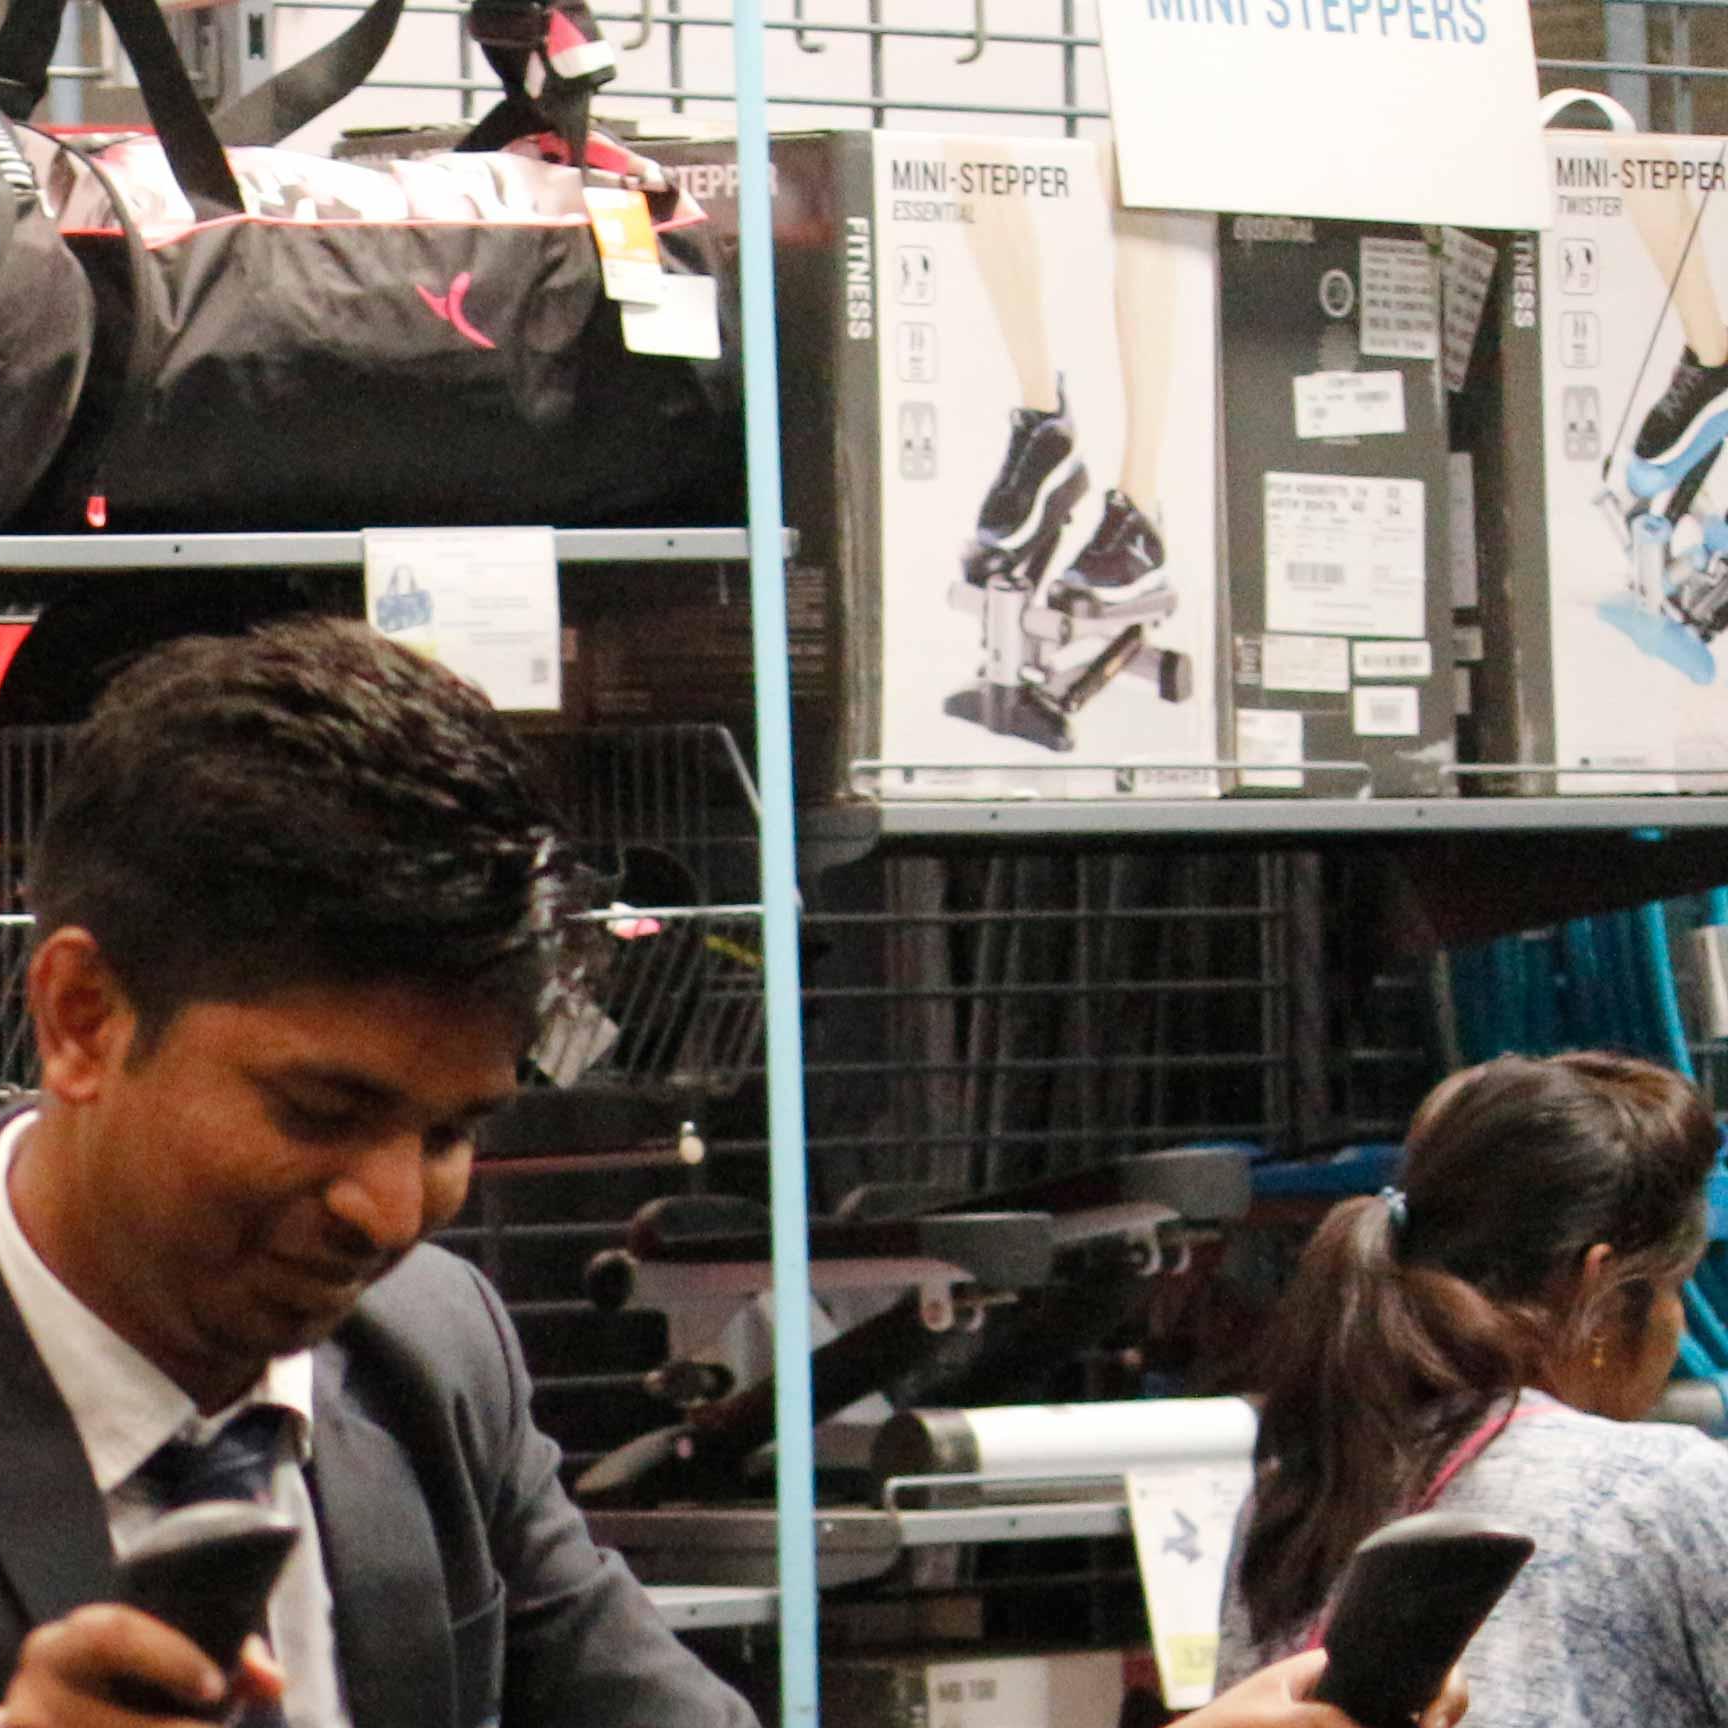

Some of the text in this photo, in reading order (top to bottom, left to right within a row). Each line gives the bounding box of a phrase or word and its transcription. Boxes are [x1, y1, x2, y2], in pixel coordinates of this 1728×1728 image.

[890, 160, 1070, 198] MINI-STEPPER
[1555, 156, 1728, 191] MINI-STEPPER
[891, 200, 976, 225] ESSENTIAL
[1556, 195, 1623, 217] TWISTER
[846, 216, 873, 340] FITNESS
[1512, 232, 1537, 329] TNESS
